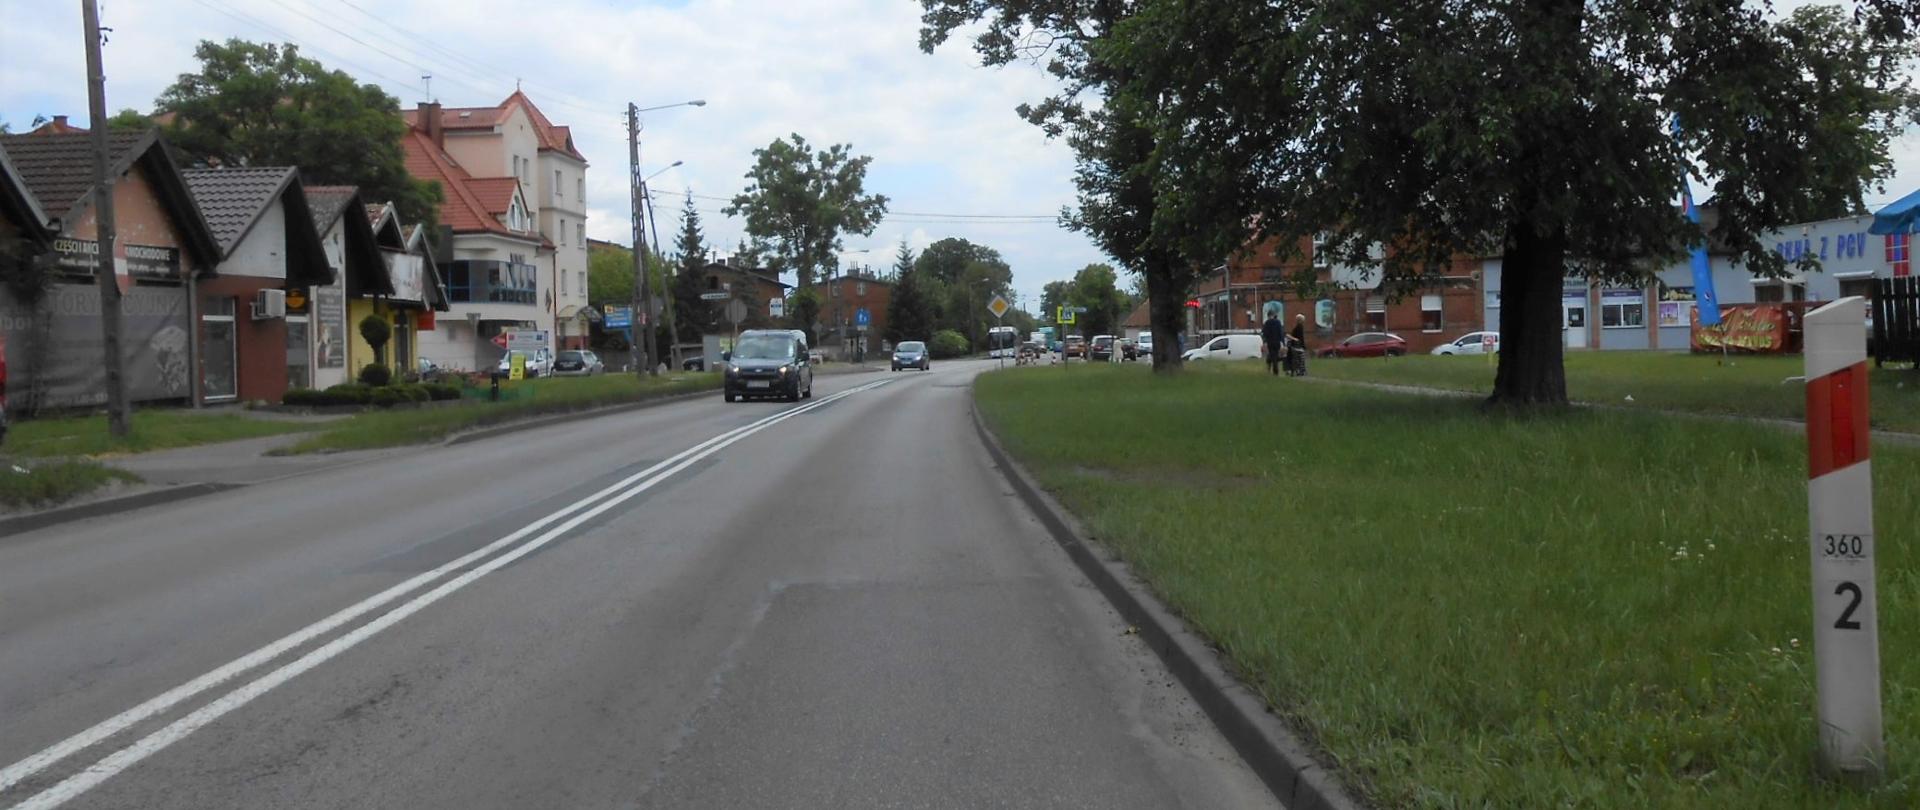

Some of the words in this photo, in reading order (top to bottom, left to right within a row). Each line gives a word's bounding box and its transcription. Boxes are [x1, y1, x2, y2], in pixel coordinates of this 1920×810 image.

[1820, 236, 1829, 260] Z
[1837, 232, 1867, 258] PCV
[1825, 535, 1863, 555] 360
[1834, 581, 1862, 630] 2
